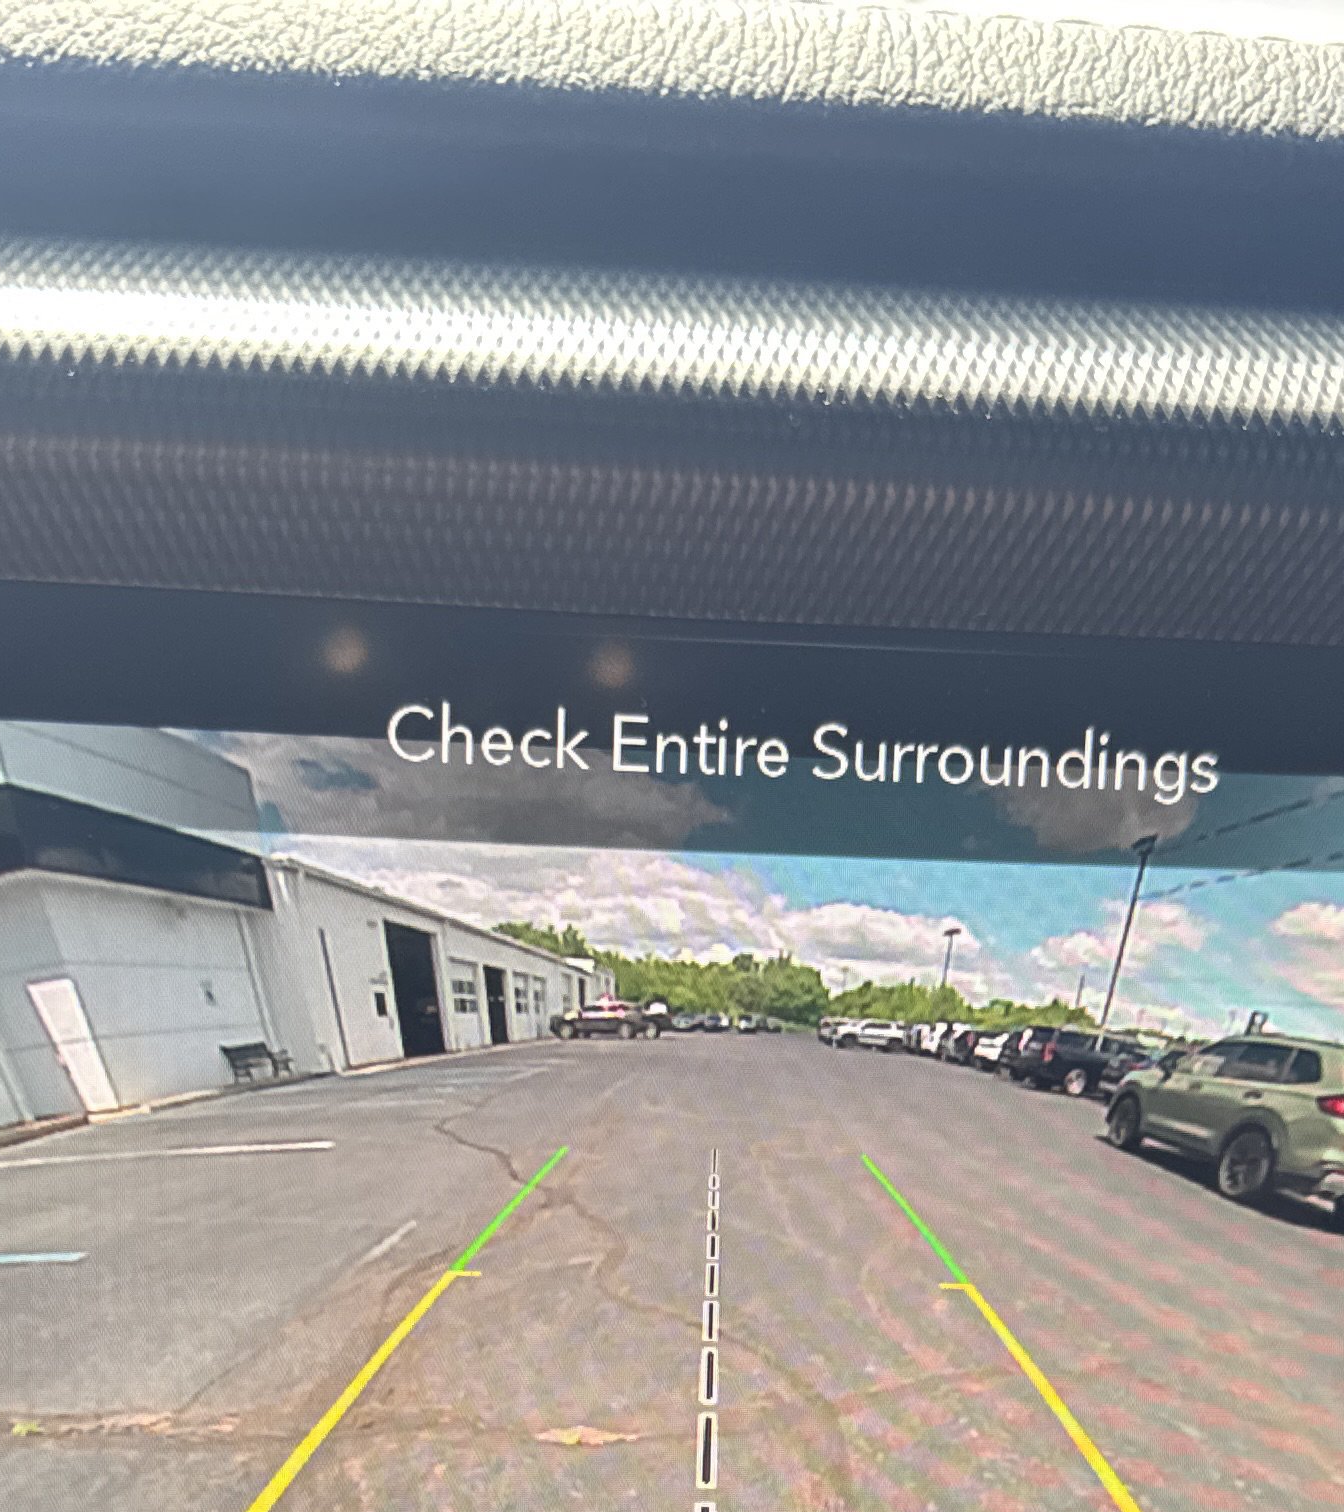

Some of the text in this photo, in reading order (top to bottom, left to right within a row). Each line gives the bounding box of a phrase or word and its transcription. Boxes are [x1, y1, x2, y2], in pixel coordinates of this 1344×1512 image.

[386, 701, 1220, 806] Check Entire Surroundings
